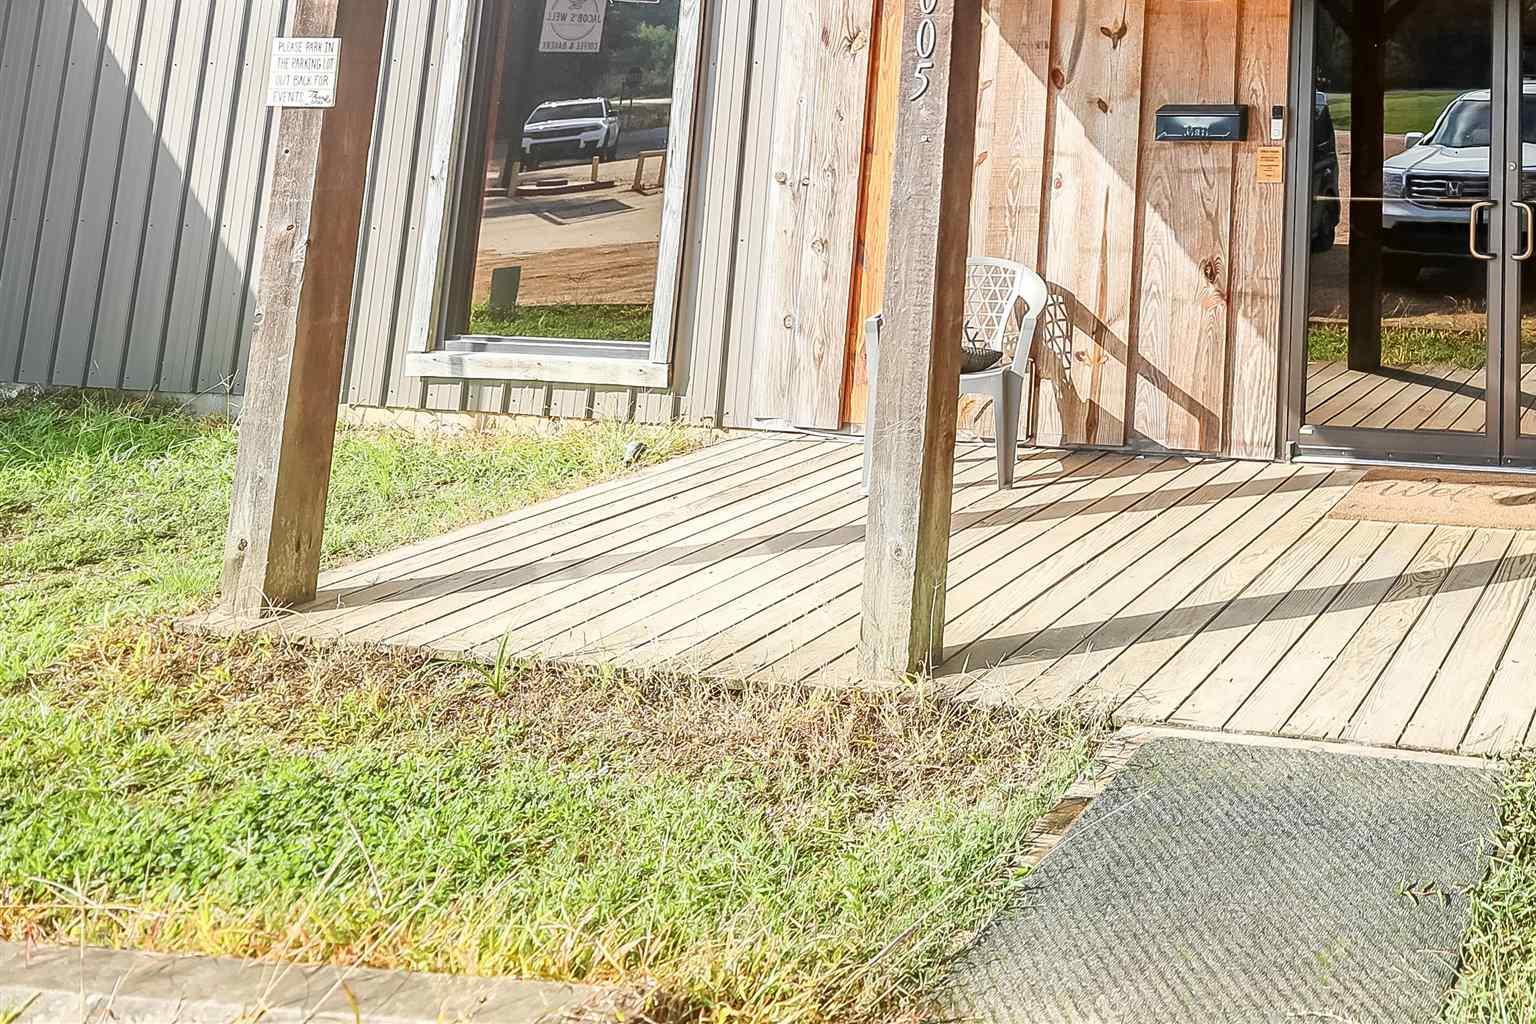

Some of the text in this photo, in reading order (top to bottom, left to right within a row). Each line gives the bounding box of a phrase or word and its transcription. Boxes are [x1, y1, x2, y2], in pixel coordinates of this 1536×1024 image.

[278, 41, 335, 53] PLEASE PARK IN
[291, 57, 322, 70] PARKING
